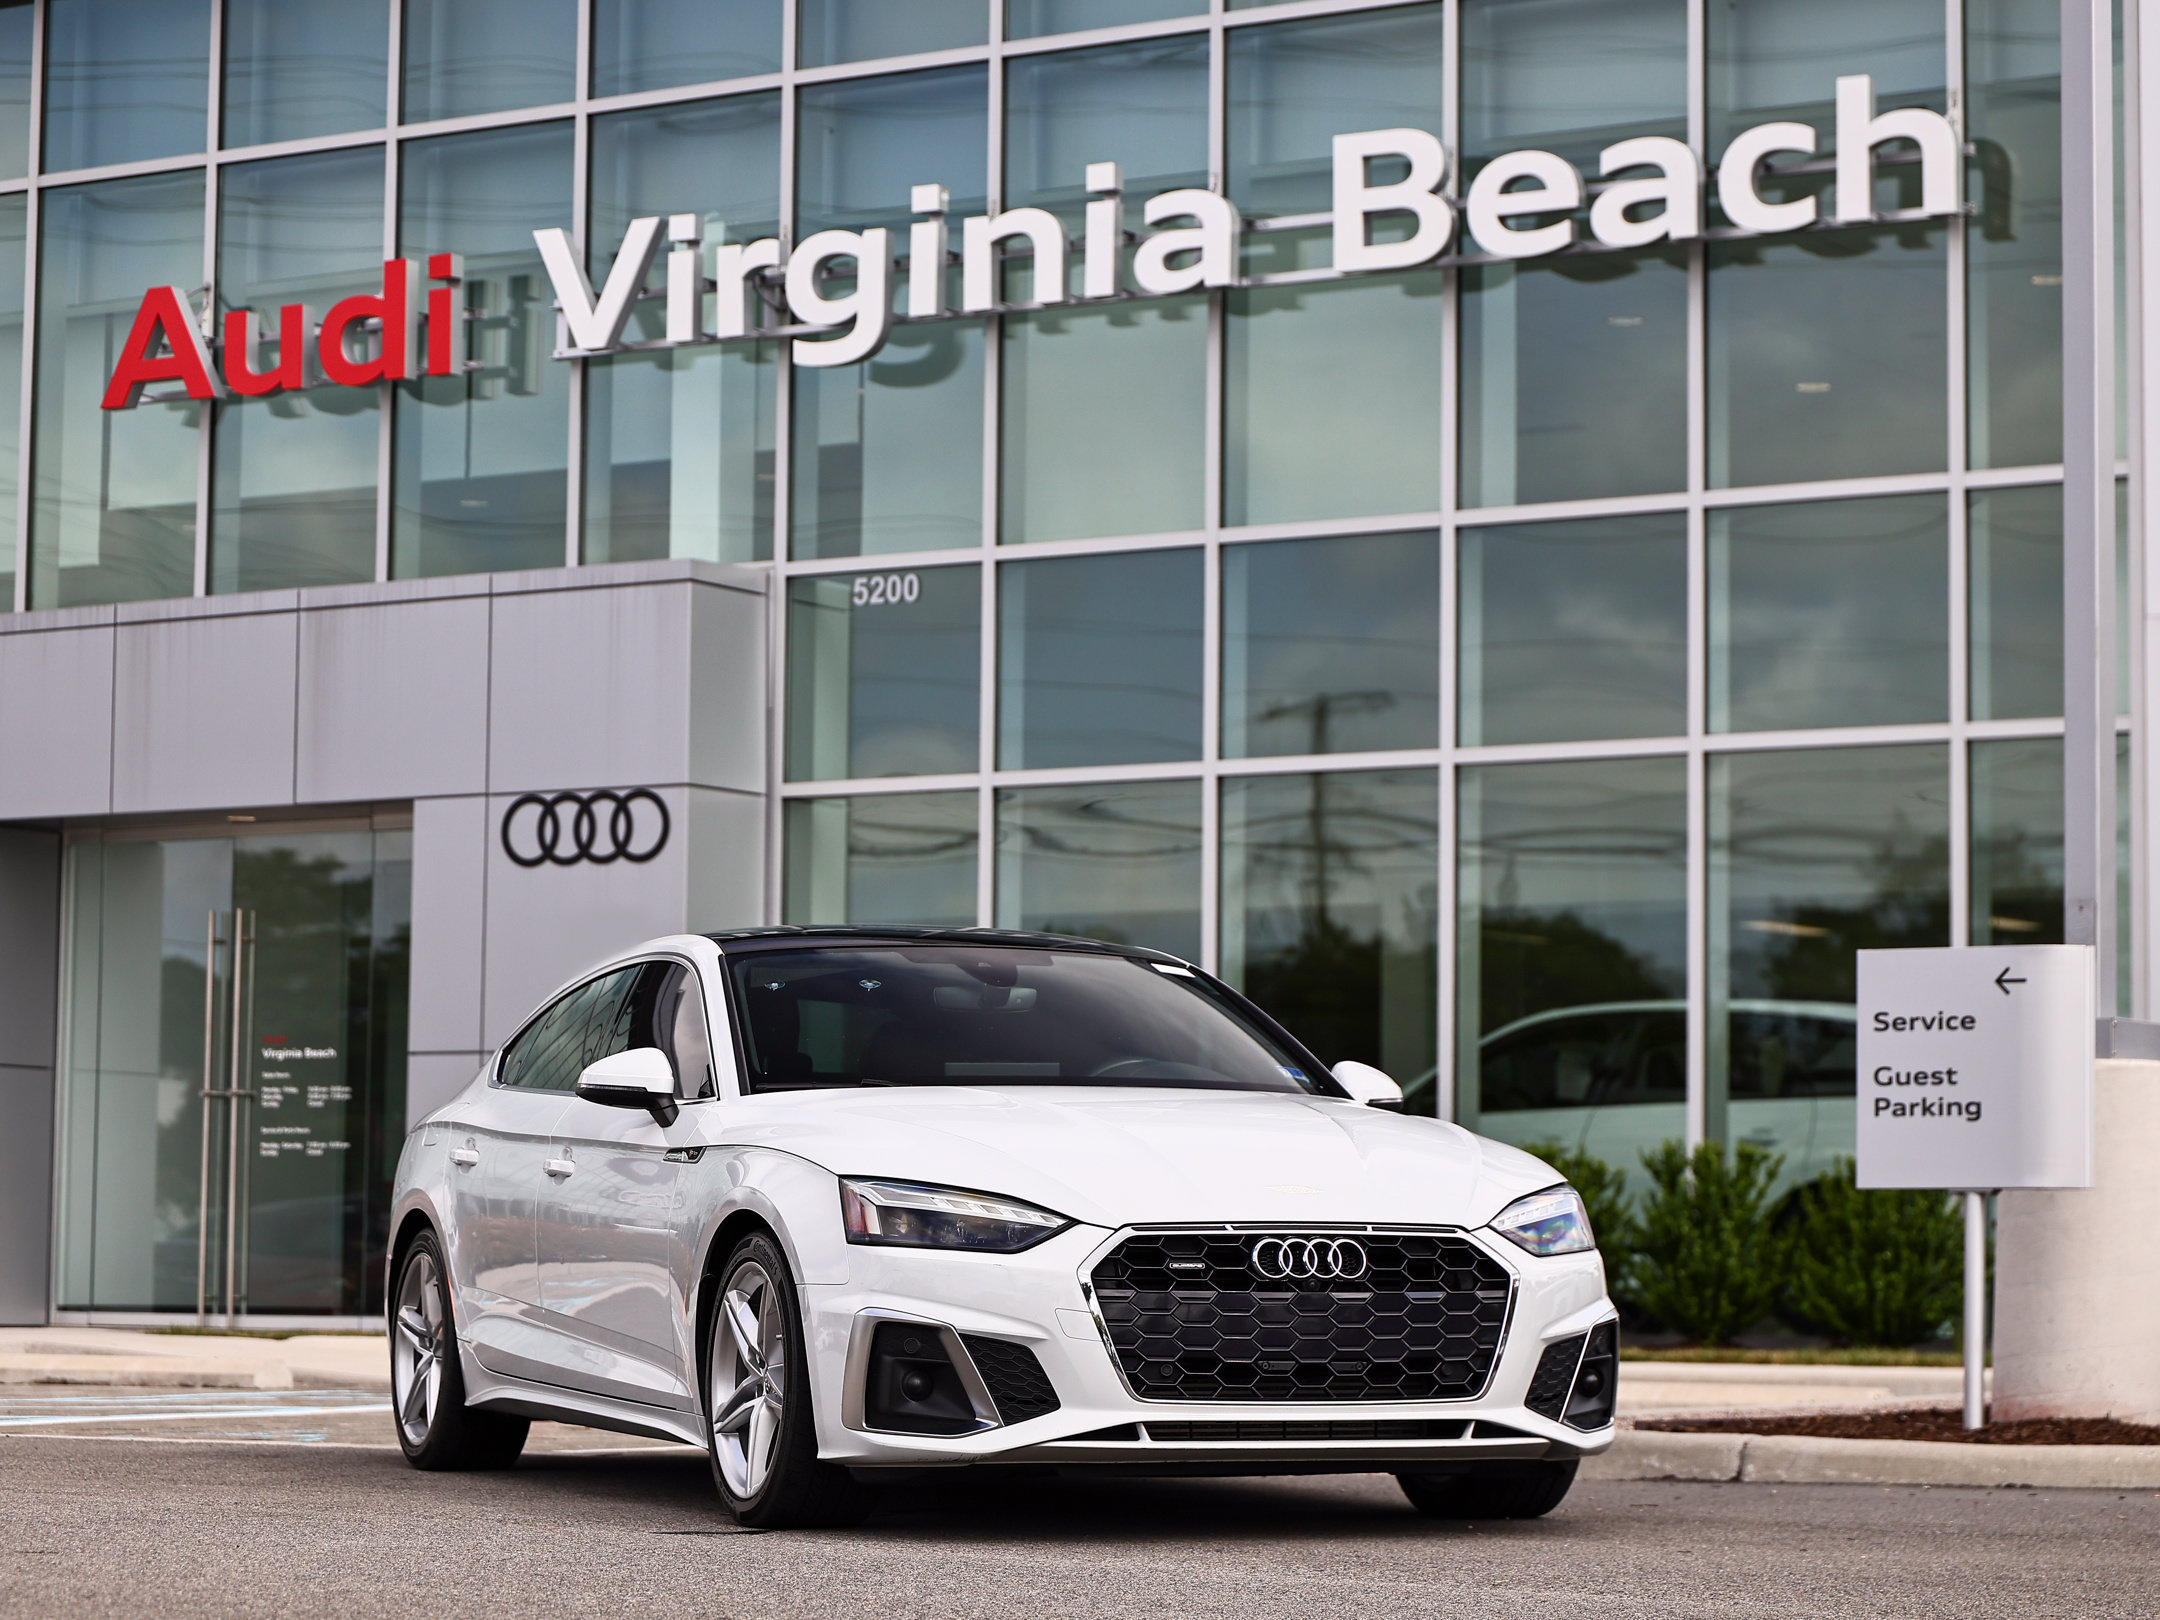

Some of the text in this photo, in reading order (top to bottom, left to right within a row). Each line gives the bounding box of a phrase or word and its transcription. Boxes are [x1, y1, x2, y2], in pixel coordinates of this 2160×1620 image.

[101, 74, 1960, 410] Audi Virginia Beach
[853, 573, 920, 607] 5200
[1873, 1011, 1977, 1032] Service
[261, 1047, 303, 1062] Virginia
[304, 1046, 1982, 1122] Parking Beach
[1873, 1066, 1959, 1086] Guest
